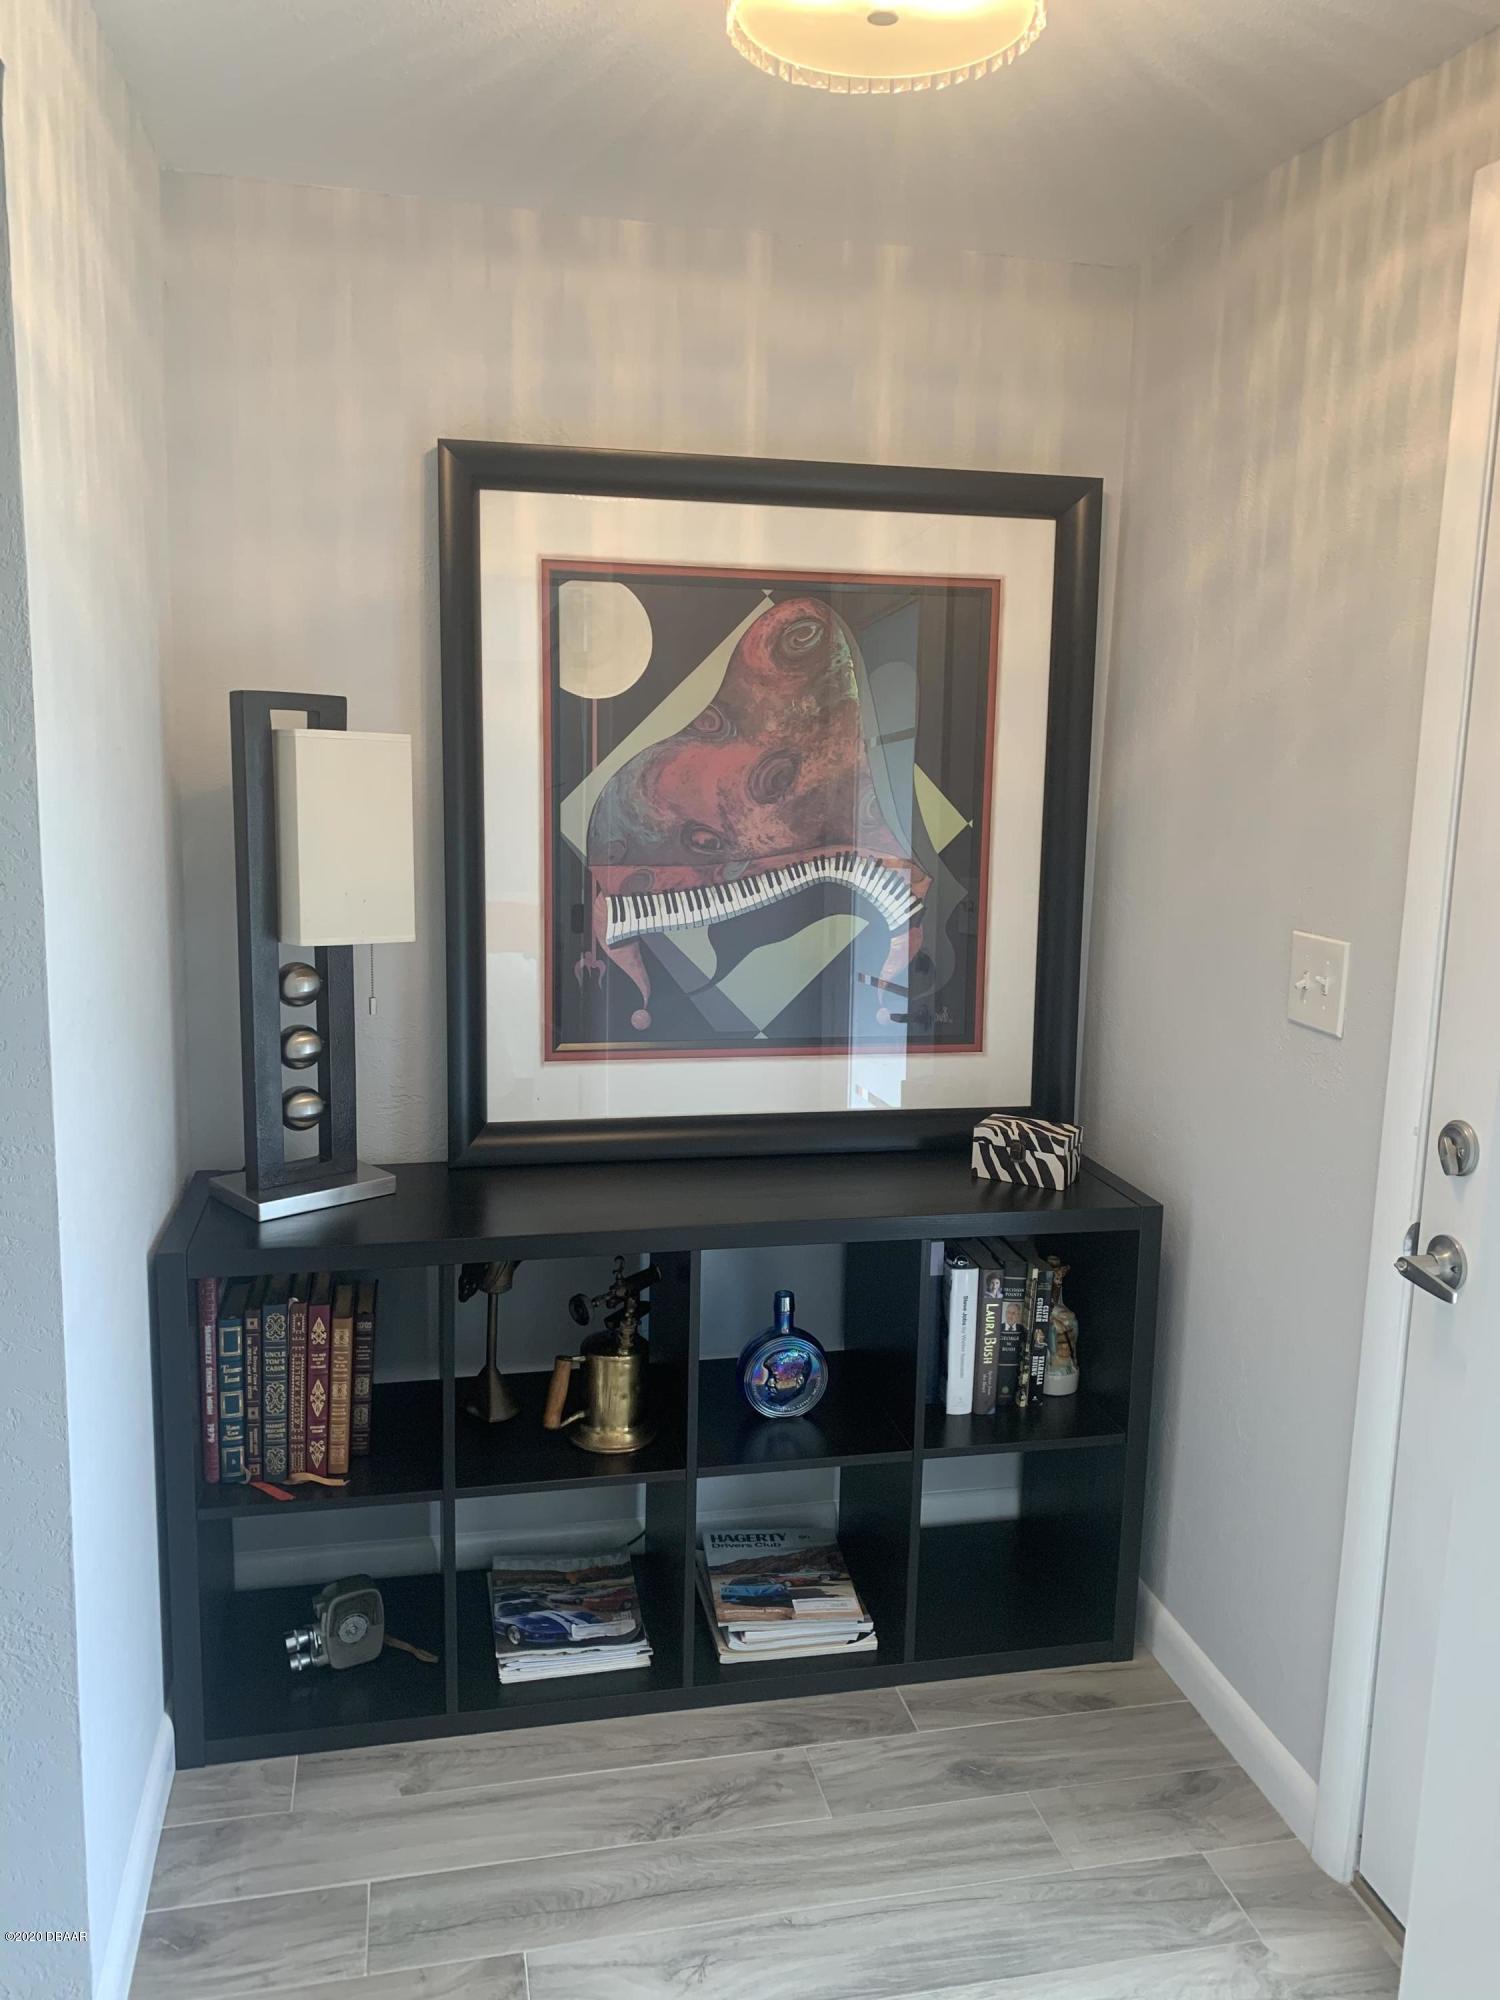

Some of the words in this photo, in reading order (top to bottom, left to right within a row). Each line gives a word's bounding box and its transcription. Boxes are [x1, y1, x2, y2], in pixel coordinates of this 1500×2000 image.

[984, 1303, 999, 1336] LAURA
[983, 1338, 997, 1364] BUSH
[710, 1533, 786, 1543] HAGERTY
